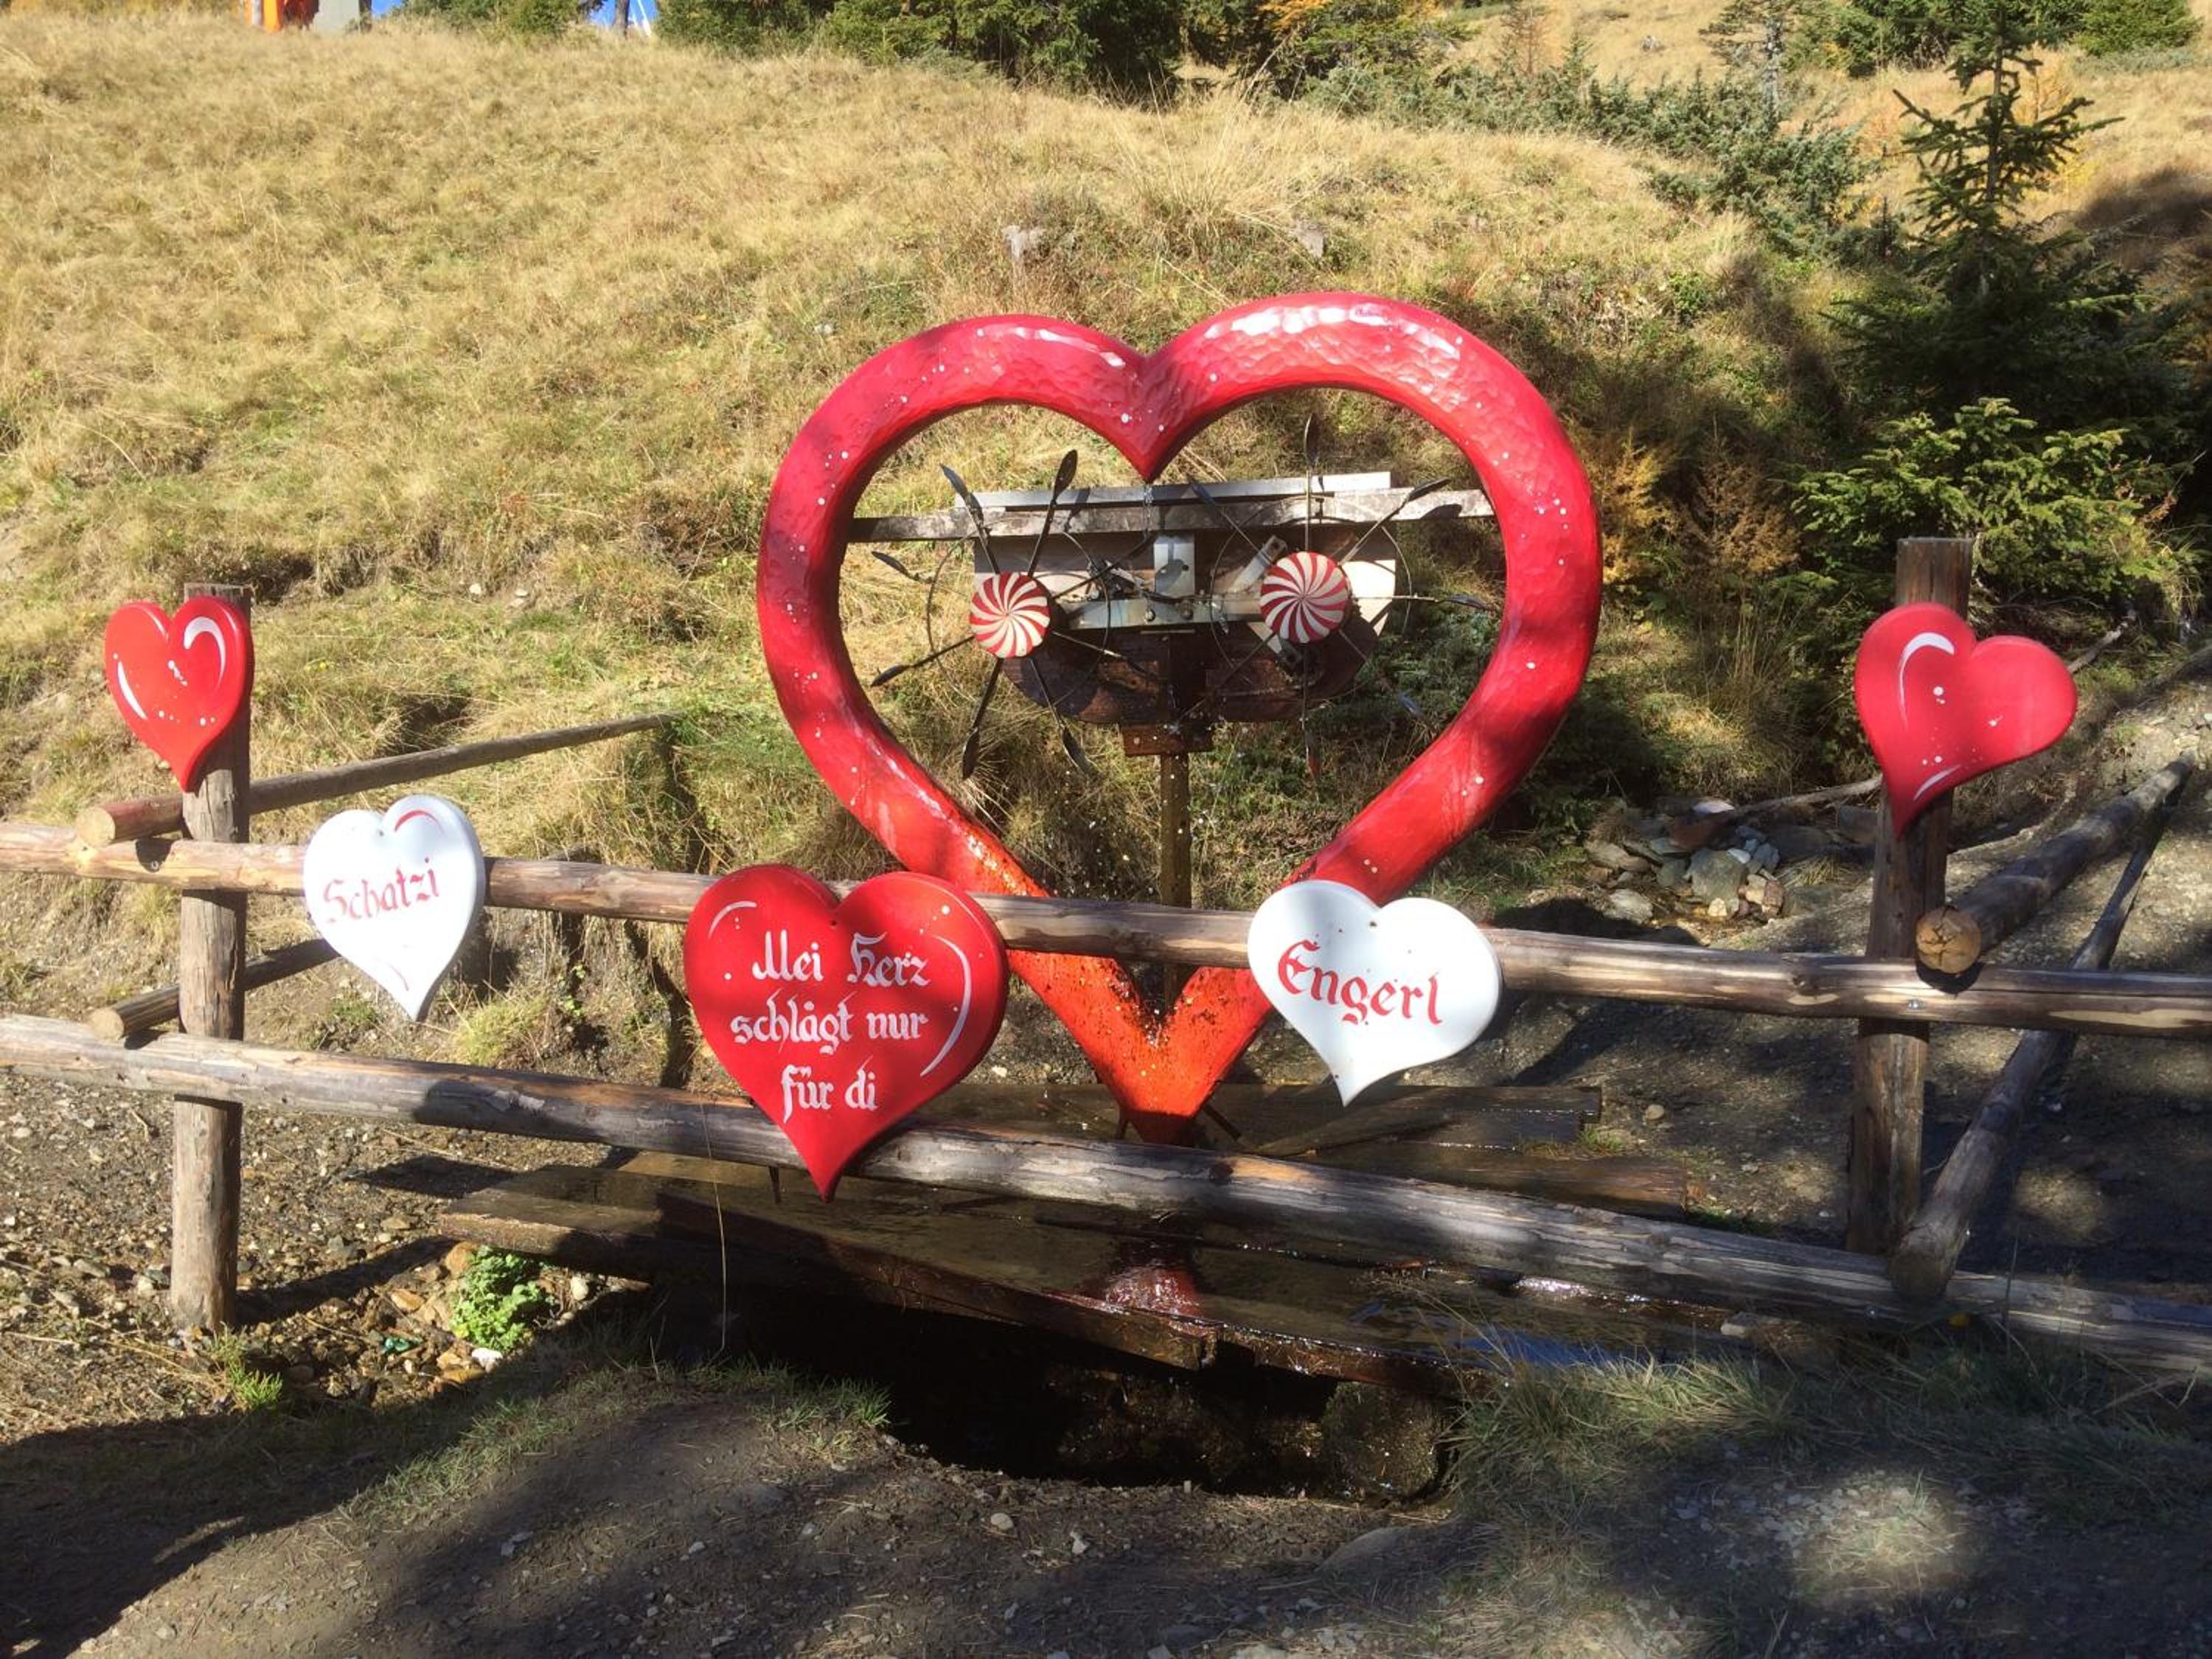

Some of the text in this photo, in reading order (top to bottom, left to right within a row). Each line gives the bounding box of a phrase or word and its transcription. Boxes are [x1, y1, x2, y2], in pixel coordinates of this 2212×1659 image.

[751, 929, 931, 987] Mei Herz
[1278, 939, 1442, 1026] Engerl
[866, 1011, 928, 1040] nur
[780, 1055, 878, 1124] für di
